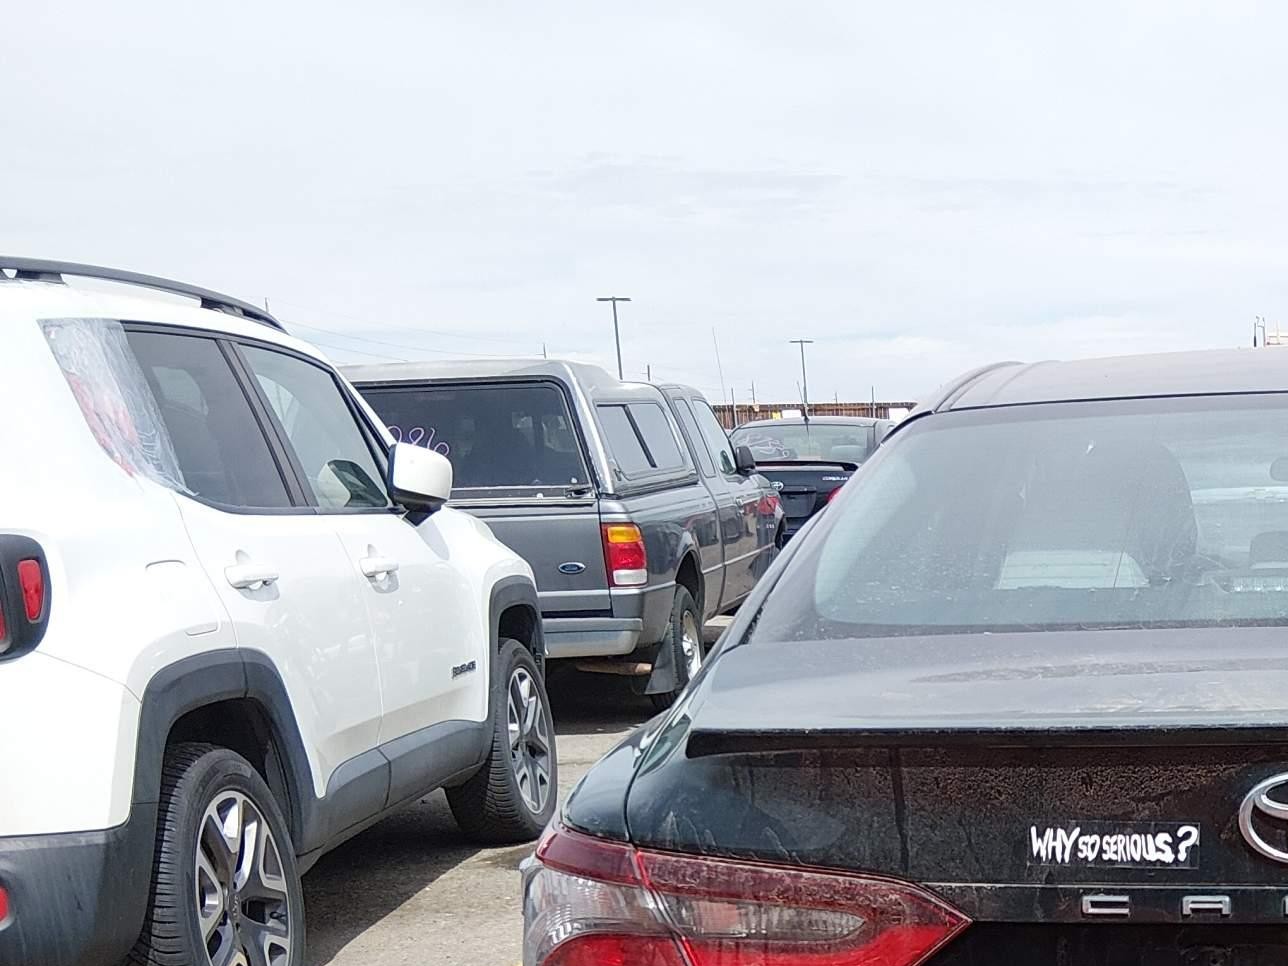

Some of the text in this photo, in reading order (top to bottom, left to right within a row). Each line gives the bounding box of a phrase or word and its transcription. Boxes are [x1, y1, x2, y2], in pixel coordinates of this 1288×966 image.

[1030, 825, 1199, 864] WHY SO SERIOUS?
